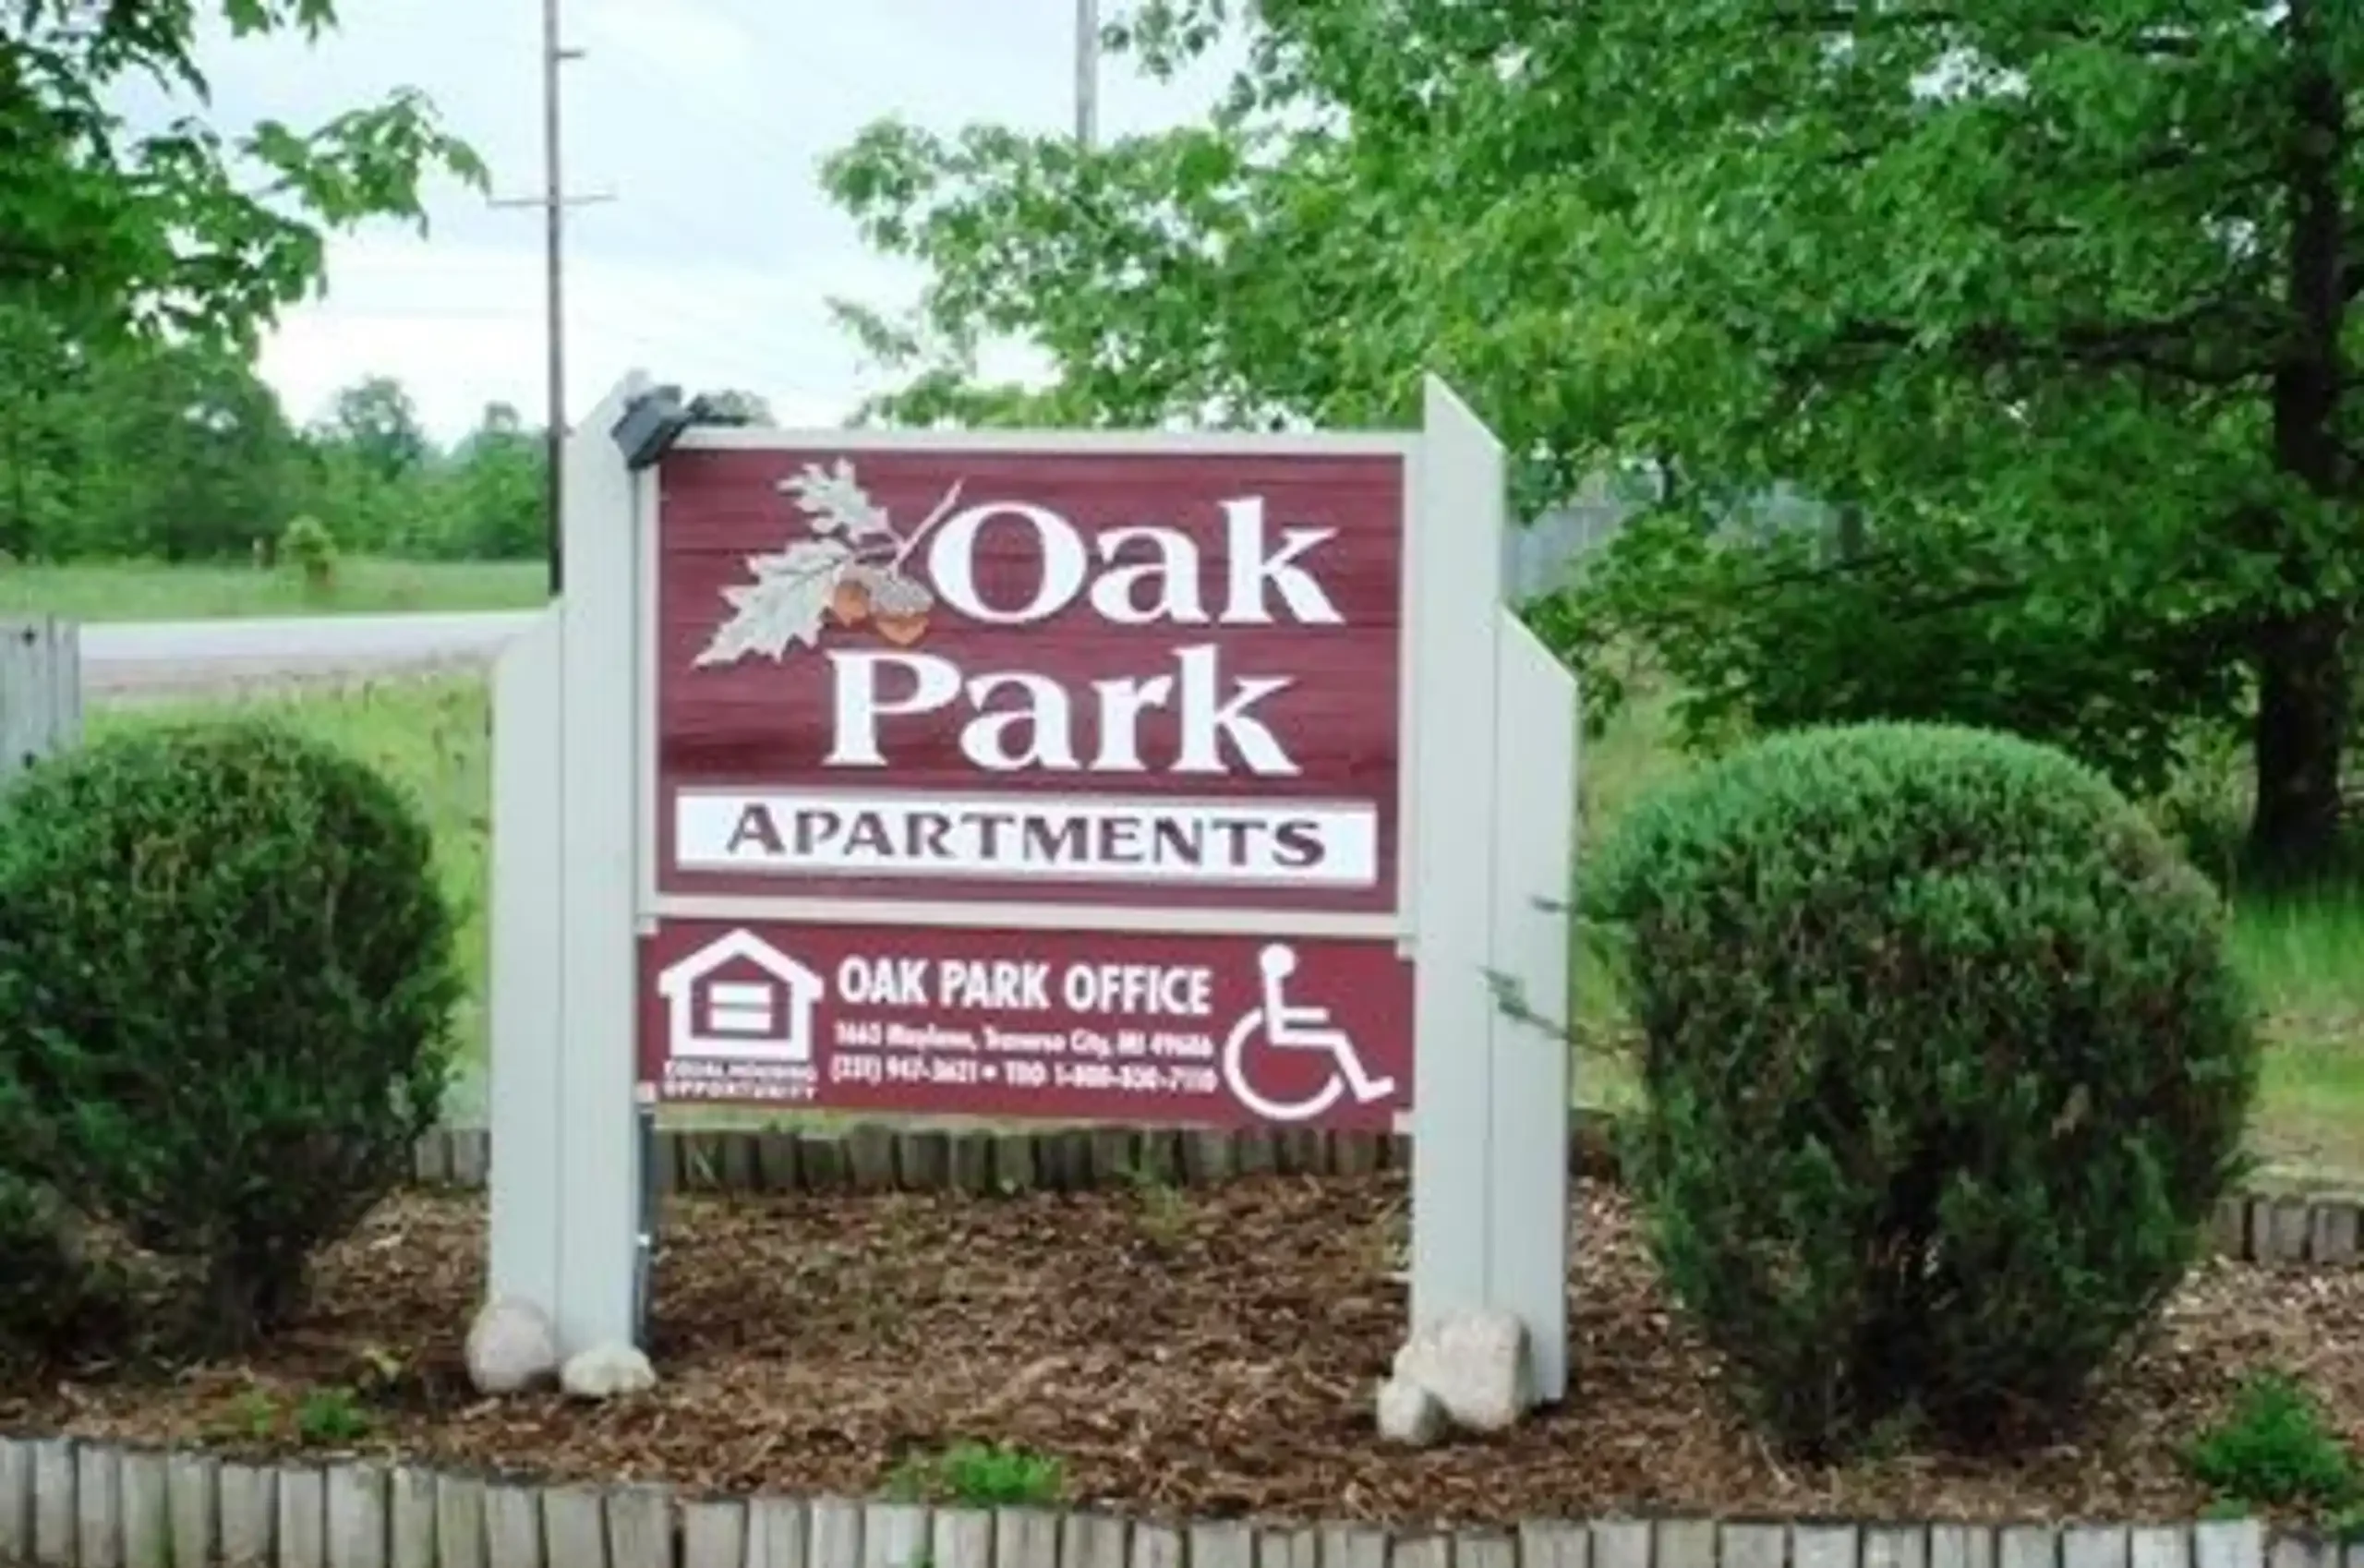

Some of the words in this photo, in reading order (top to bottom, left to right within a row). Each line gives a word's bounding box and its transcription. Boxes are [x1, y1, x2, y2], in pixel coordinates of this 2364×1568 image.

[928, 496, 1345, 625] Oak
[822, 644, 1301, 775] Park
[726, 802, 1326, 868] APARTMENTS
[838, 954, 928, 1004] OAK
[939, 959, 1050, 1009] PARK
[1064, 963, 1212, 1014] OFFICE
[1117, 1029, 1146, 1055] MI
[663, 1080, 819, 1100] OPPORTUNITY
